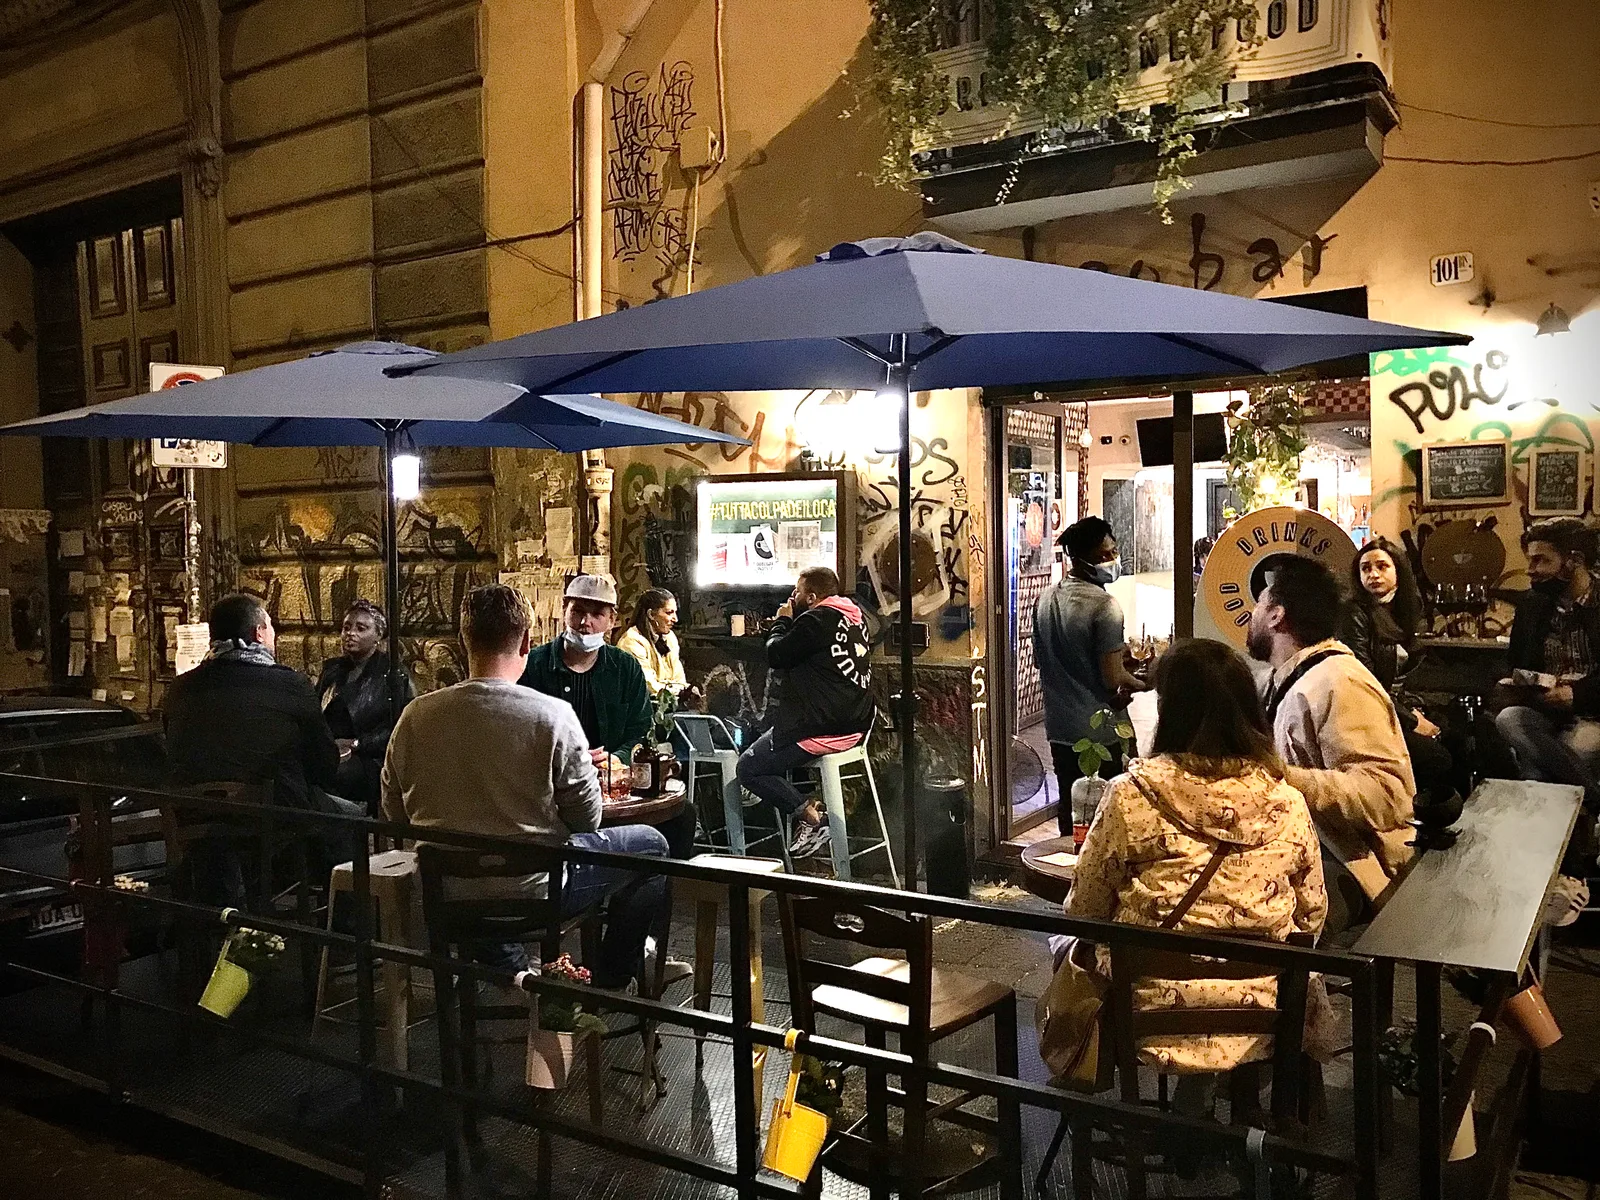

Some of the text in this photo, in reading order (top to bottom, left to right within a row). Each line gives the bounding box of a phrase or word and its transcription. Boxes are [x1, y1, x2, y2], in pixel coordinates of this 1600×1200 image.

[1435, 256, 1459, 283] 101
[1237, 521, 1332, 556] DRINKS
[1219, 582, 1252, 627] OOD
